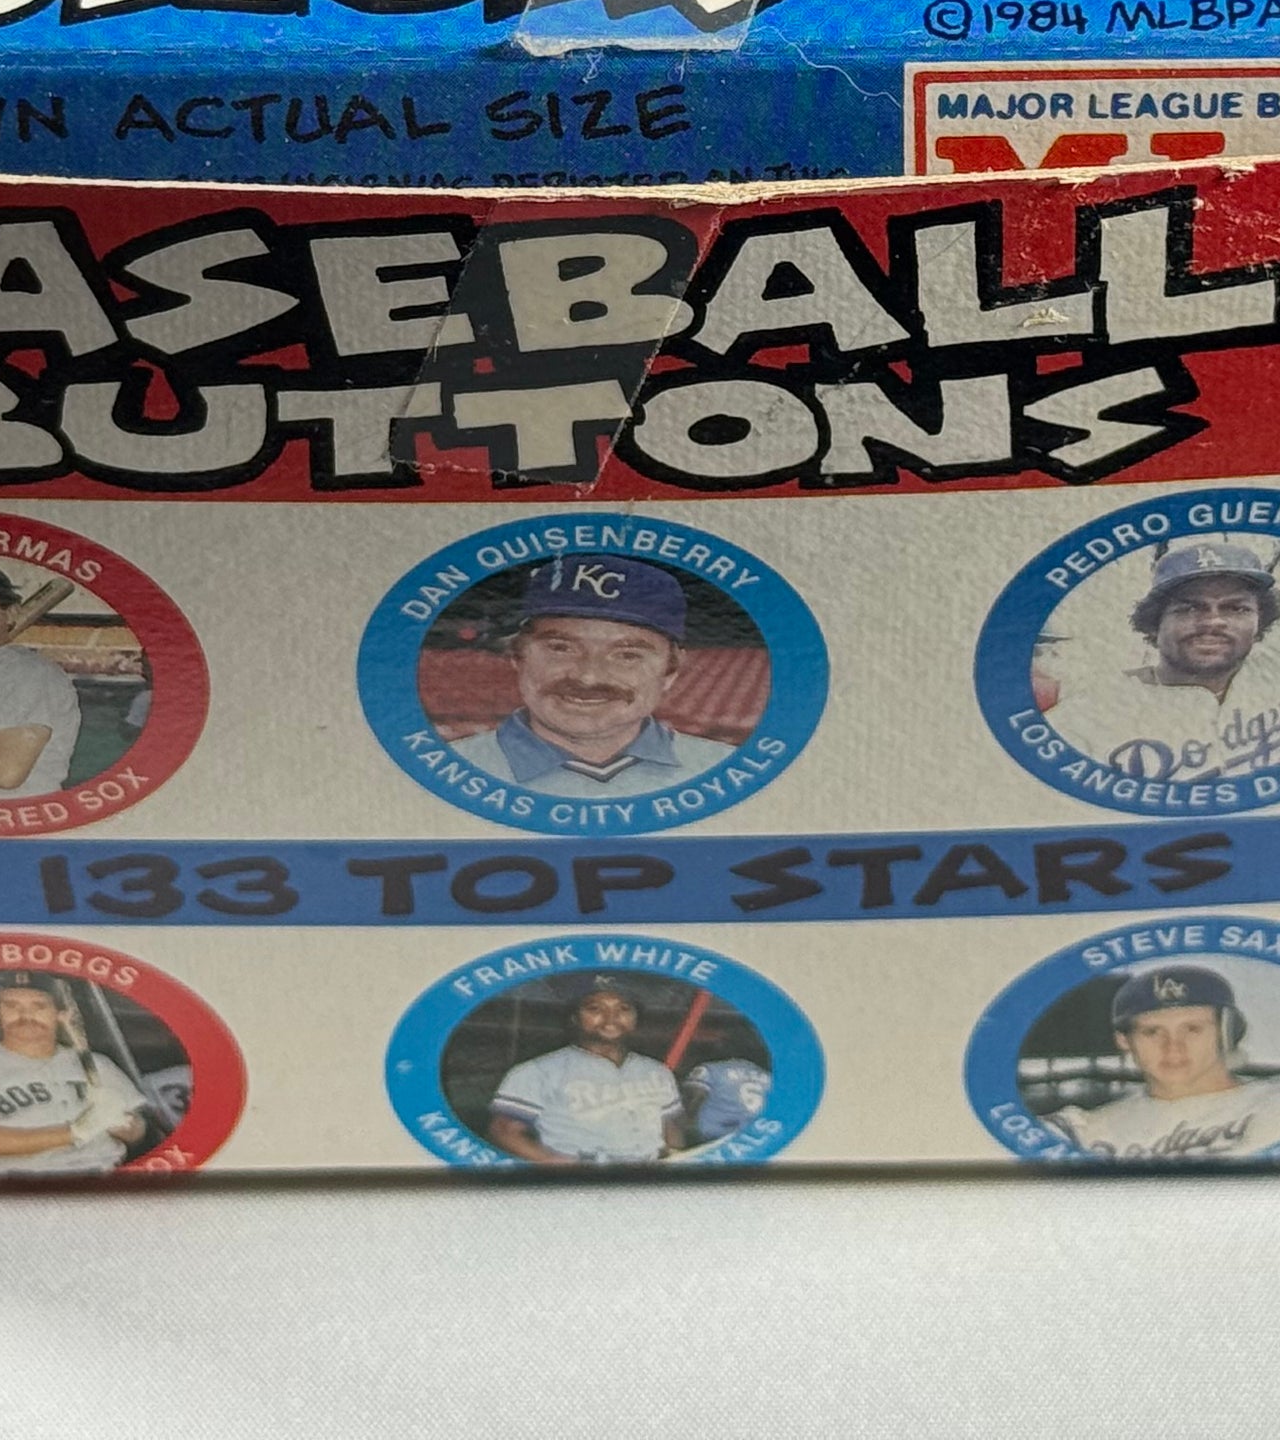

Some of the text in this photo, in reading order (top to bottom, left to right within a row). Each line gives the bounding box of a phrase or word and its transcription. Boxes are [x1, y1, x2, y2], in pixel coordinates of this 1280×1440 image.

[114, 90, 452, 147] ACTUAL
[484, 83, 693, 142] SIZE
[937, 91, 1073, 121] MAJOR
[1088, 90, 1242, 120] LEAGUE
[401, 525, 761, 622] DAN QUISENBERRY
[1045, 512, 1170, 590] PEDRO
[572, 563, 626, 599] KC
[402, 728, 788, 827] KANSAS CITY ROYALS
[1008, 707, 1065, 760] LOS
[1061, 756, 1238, 808] ANGELES
[78, 766, 150, 812] SOX
[37, 832, 1234, 918] 133 TOP STARS
[0, 942, 140, 989] BOGGS
[453, 941, 719, 1000] FRANK WHITE
[1081, 925, 1205, 968] STEVE
[989, 1101, 1047, 1148] LOS
